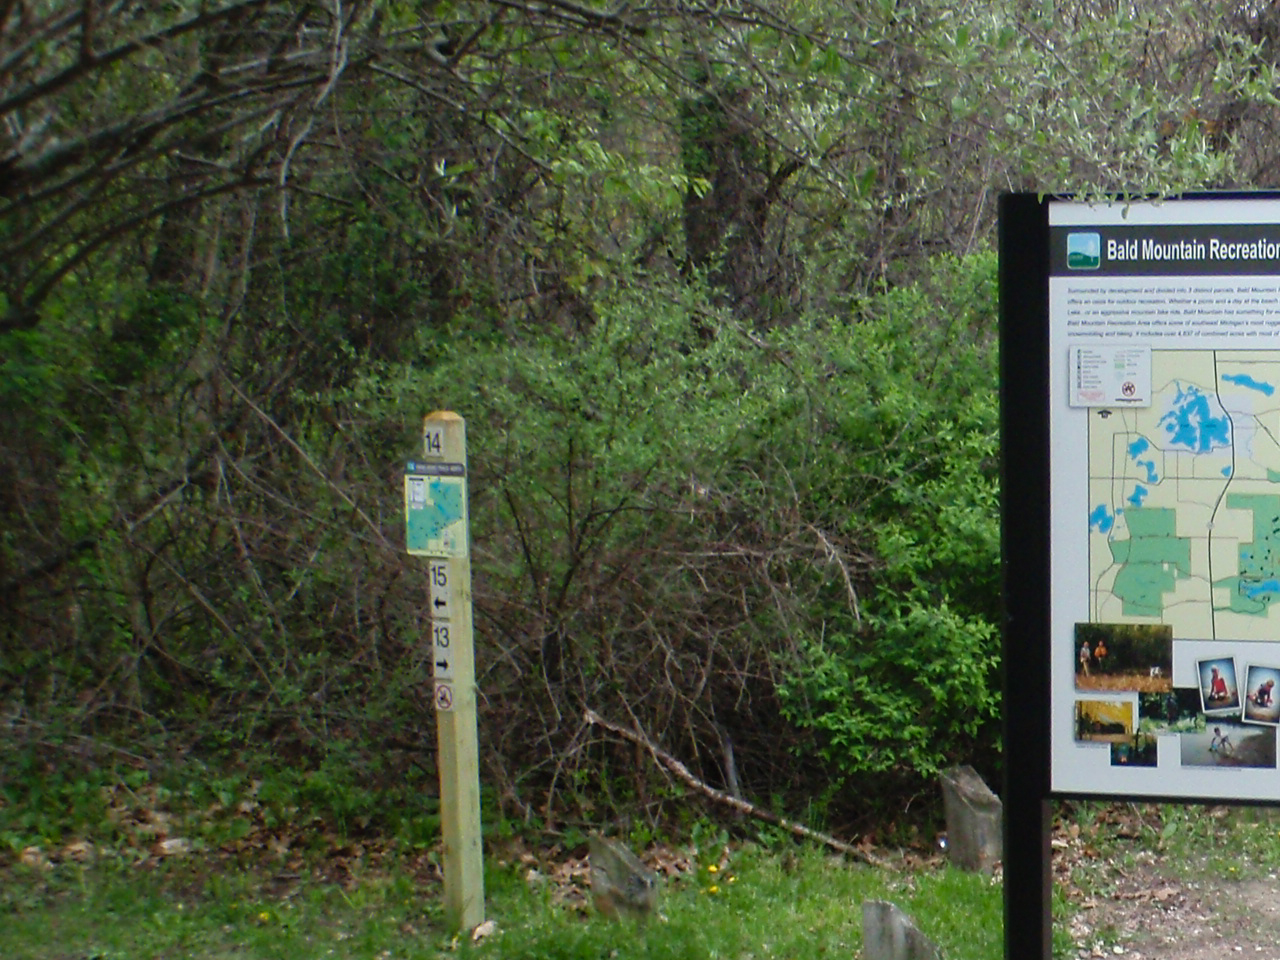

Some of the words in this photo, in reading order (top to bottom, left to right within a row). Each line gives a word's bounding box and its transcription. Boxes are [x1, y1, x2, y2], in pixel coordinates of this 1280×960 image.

[1107, 239, 1137, 260] Bald
[1142, 239, 1205, 260] Mountain
[1081, 319, 1106, 327] Mountain
[426, 432, 441, 453] 14
[431, 565, 448, 587] 15
[434, 627, 450, 649] 13
